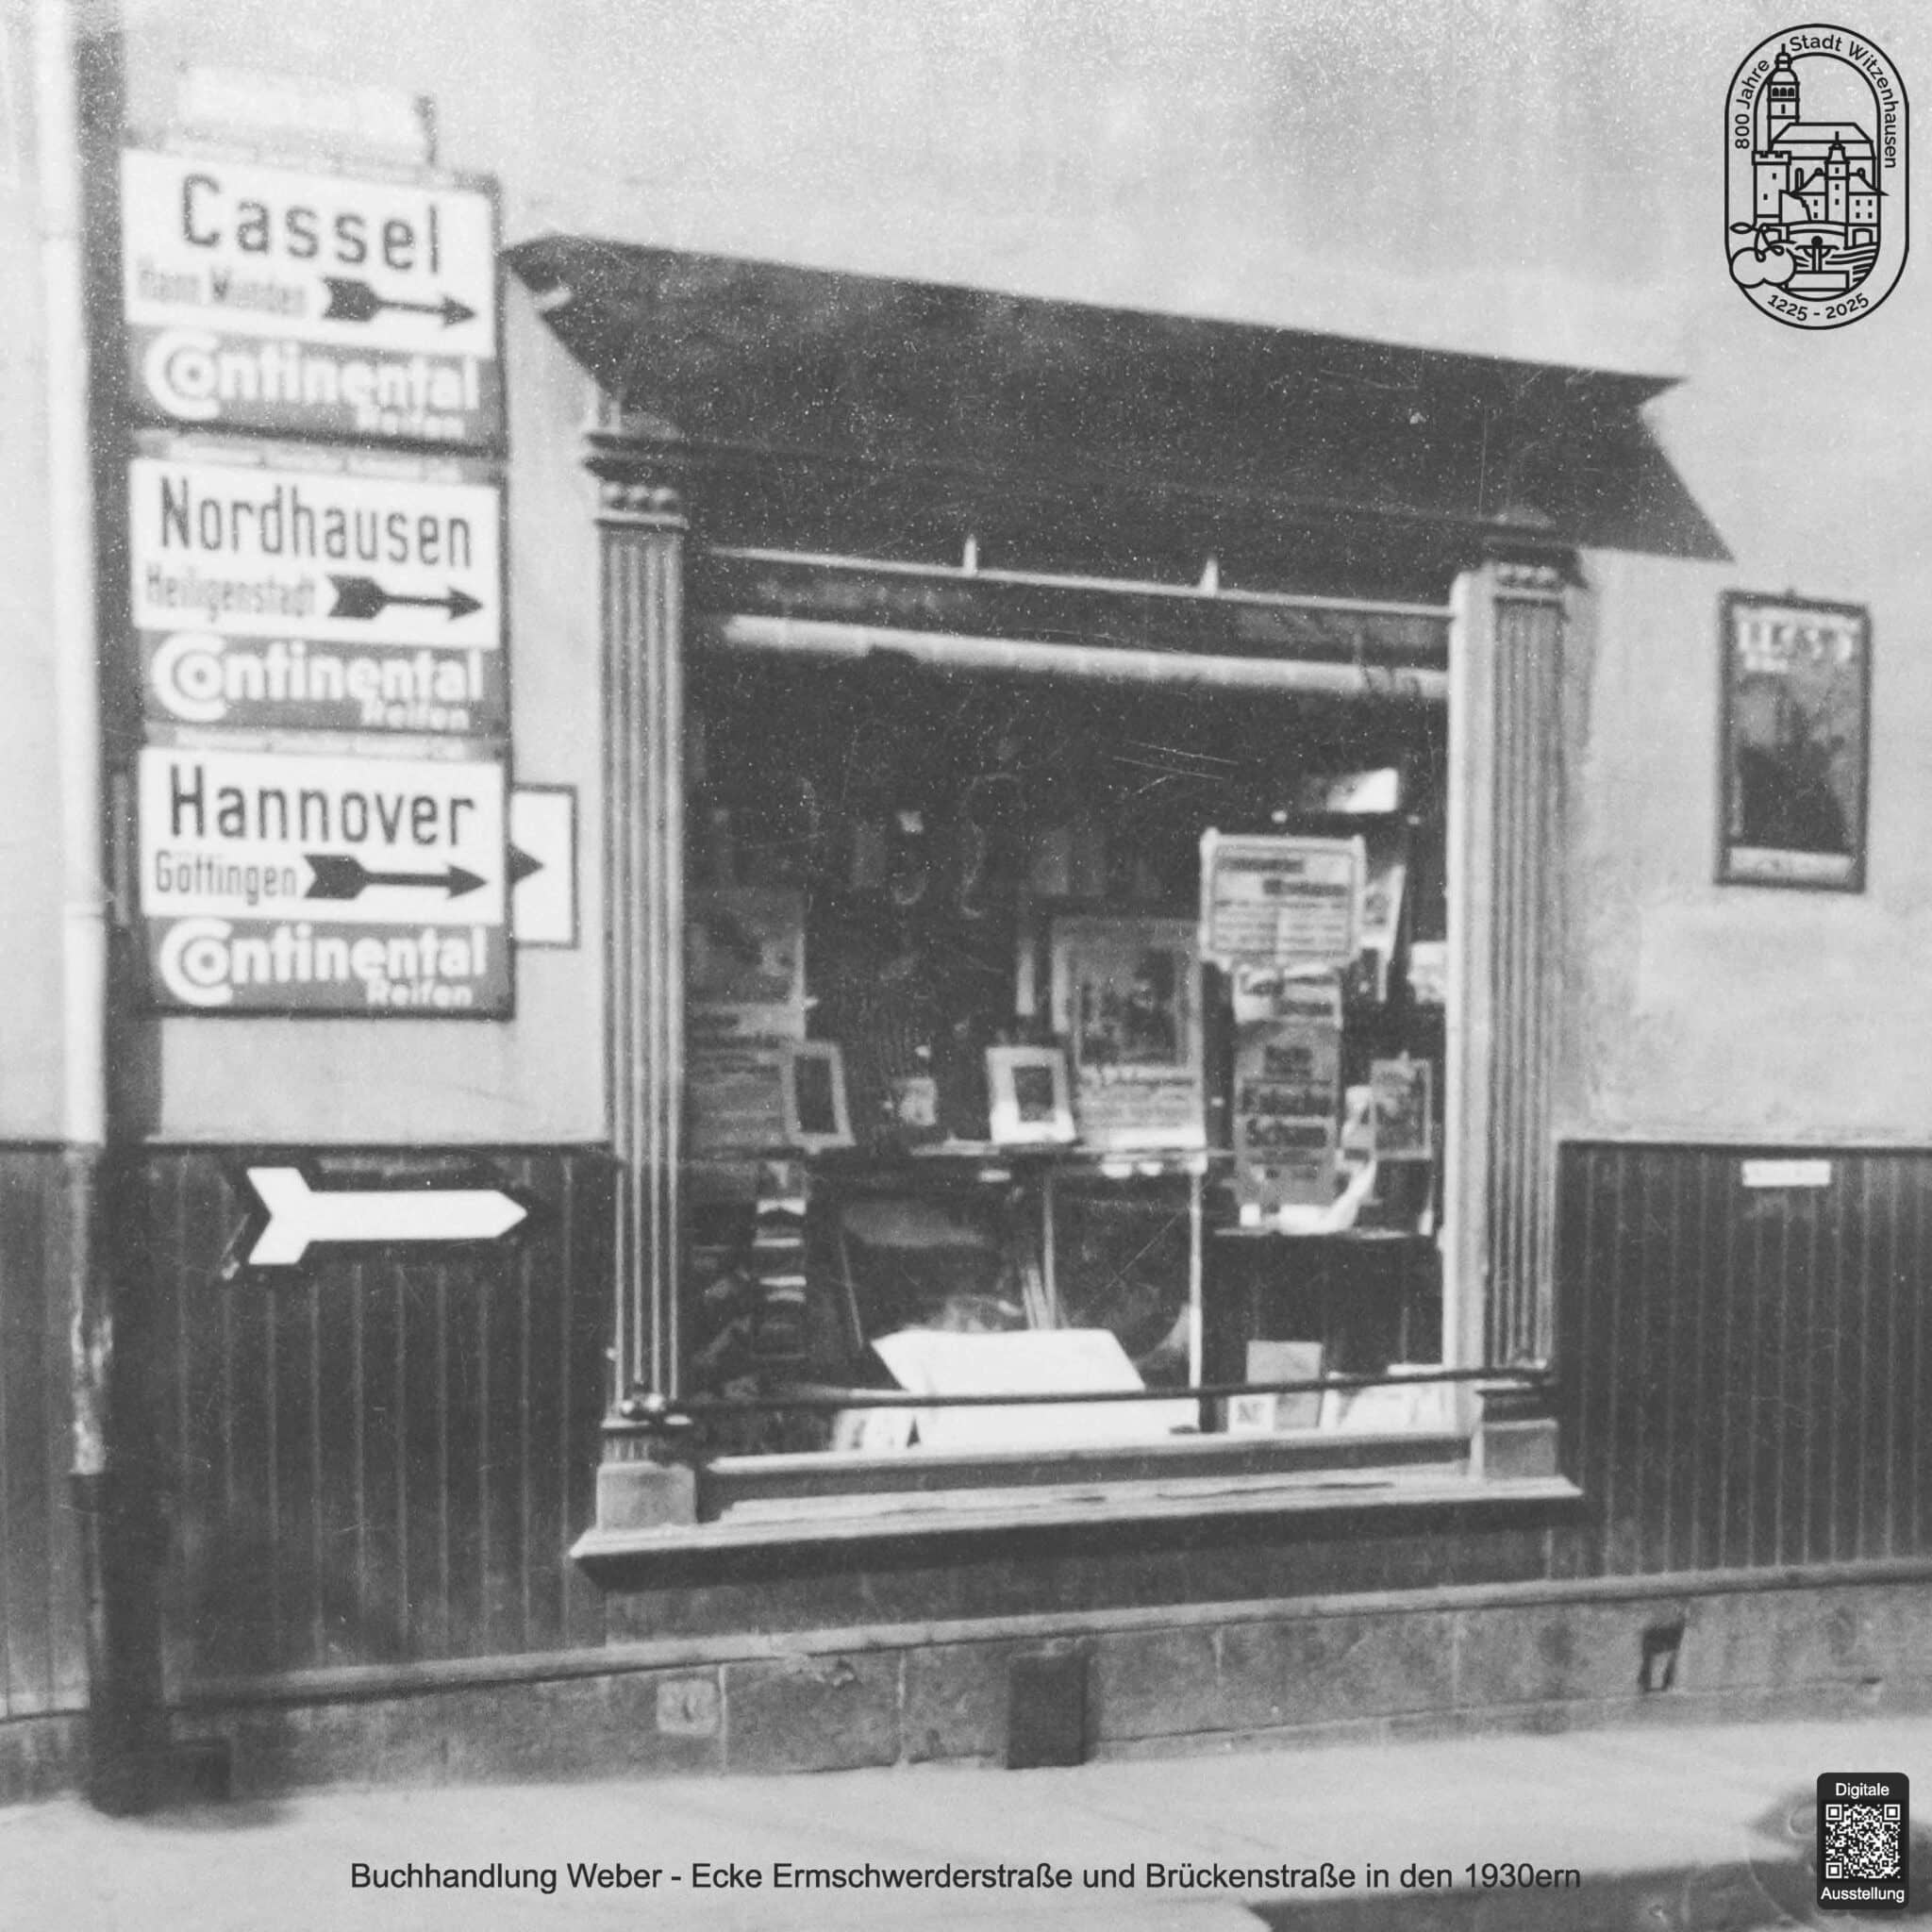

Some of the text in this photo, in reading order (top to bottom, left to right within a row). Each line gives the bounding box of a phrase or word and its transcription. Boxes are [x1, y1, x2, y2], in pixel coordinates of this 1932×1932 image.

[180, 173, 439, 275] Cassel
[145, 329, 479, 422] Continental
[159, 475, 471, 568] Nordhausen
[146, 563, 316, 623] Heiligenstadt
[151, 632, 483, 723] Continental
[169, 763, 476, 846] Hannover
[158, 918, 488, 1007] Continental
[366, 977, 473, 1008] Reifen
